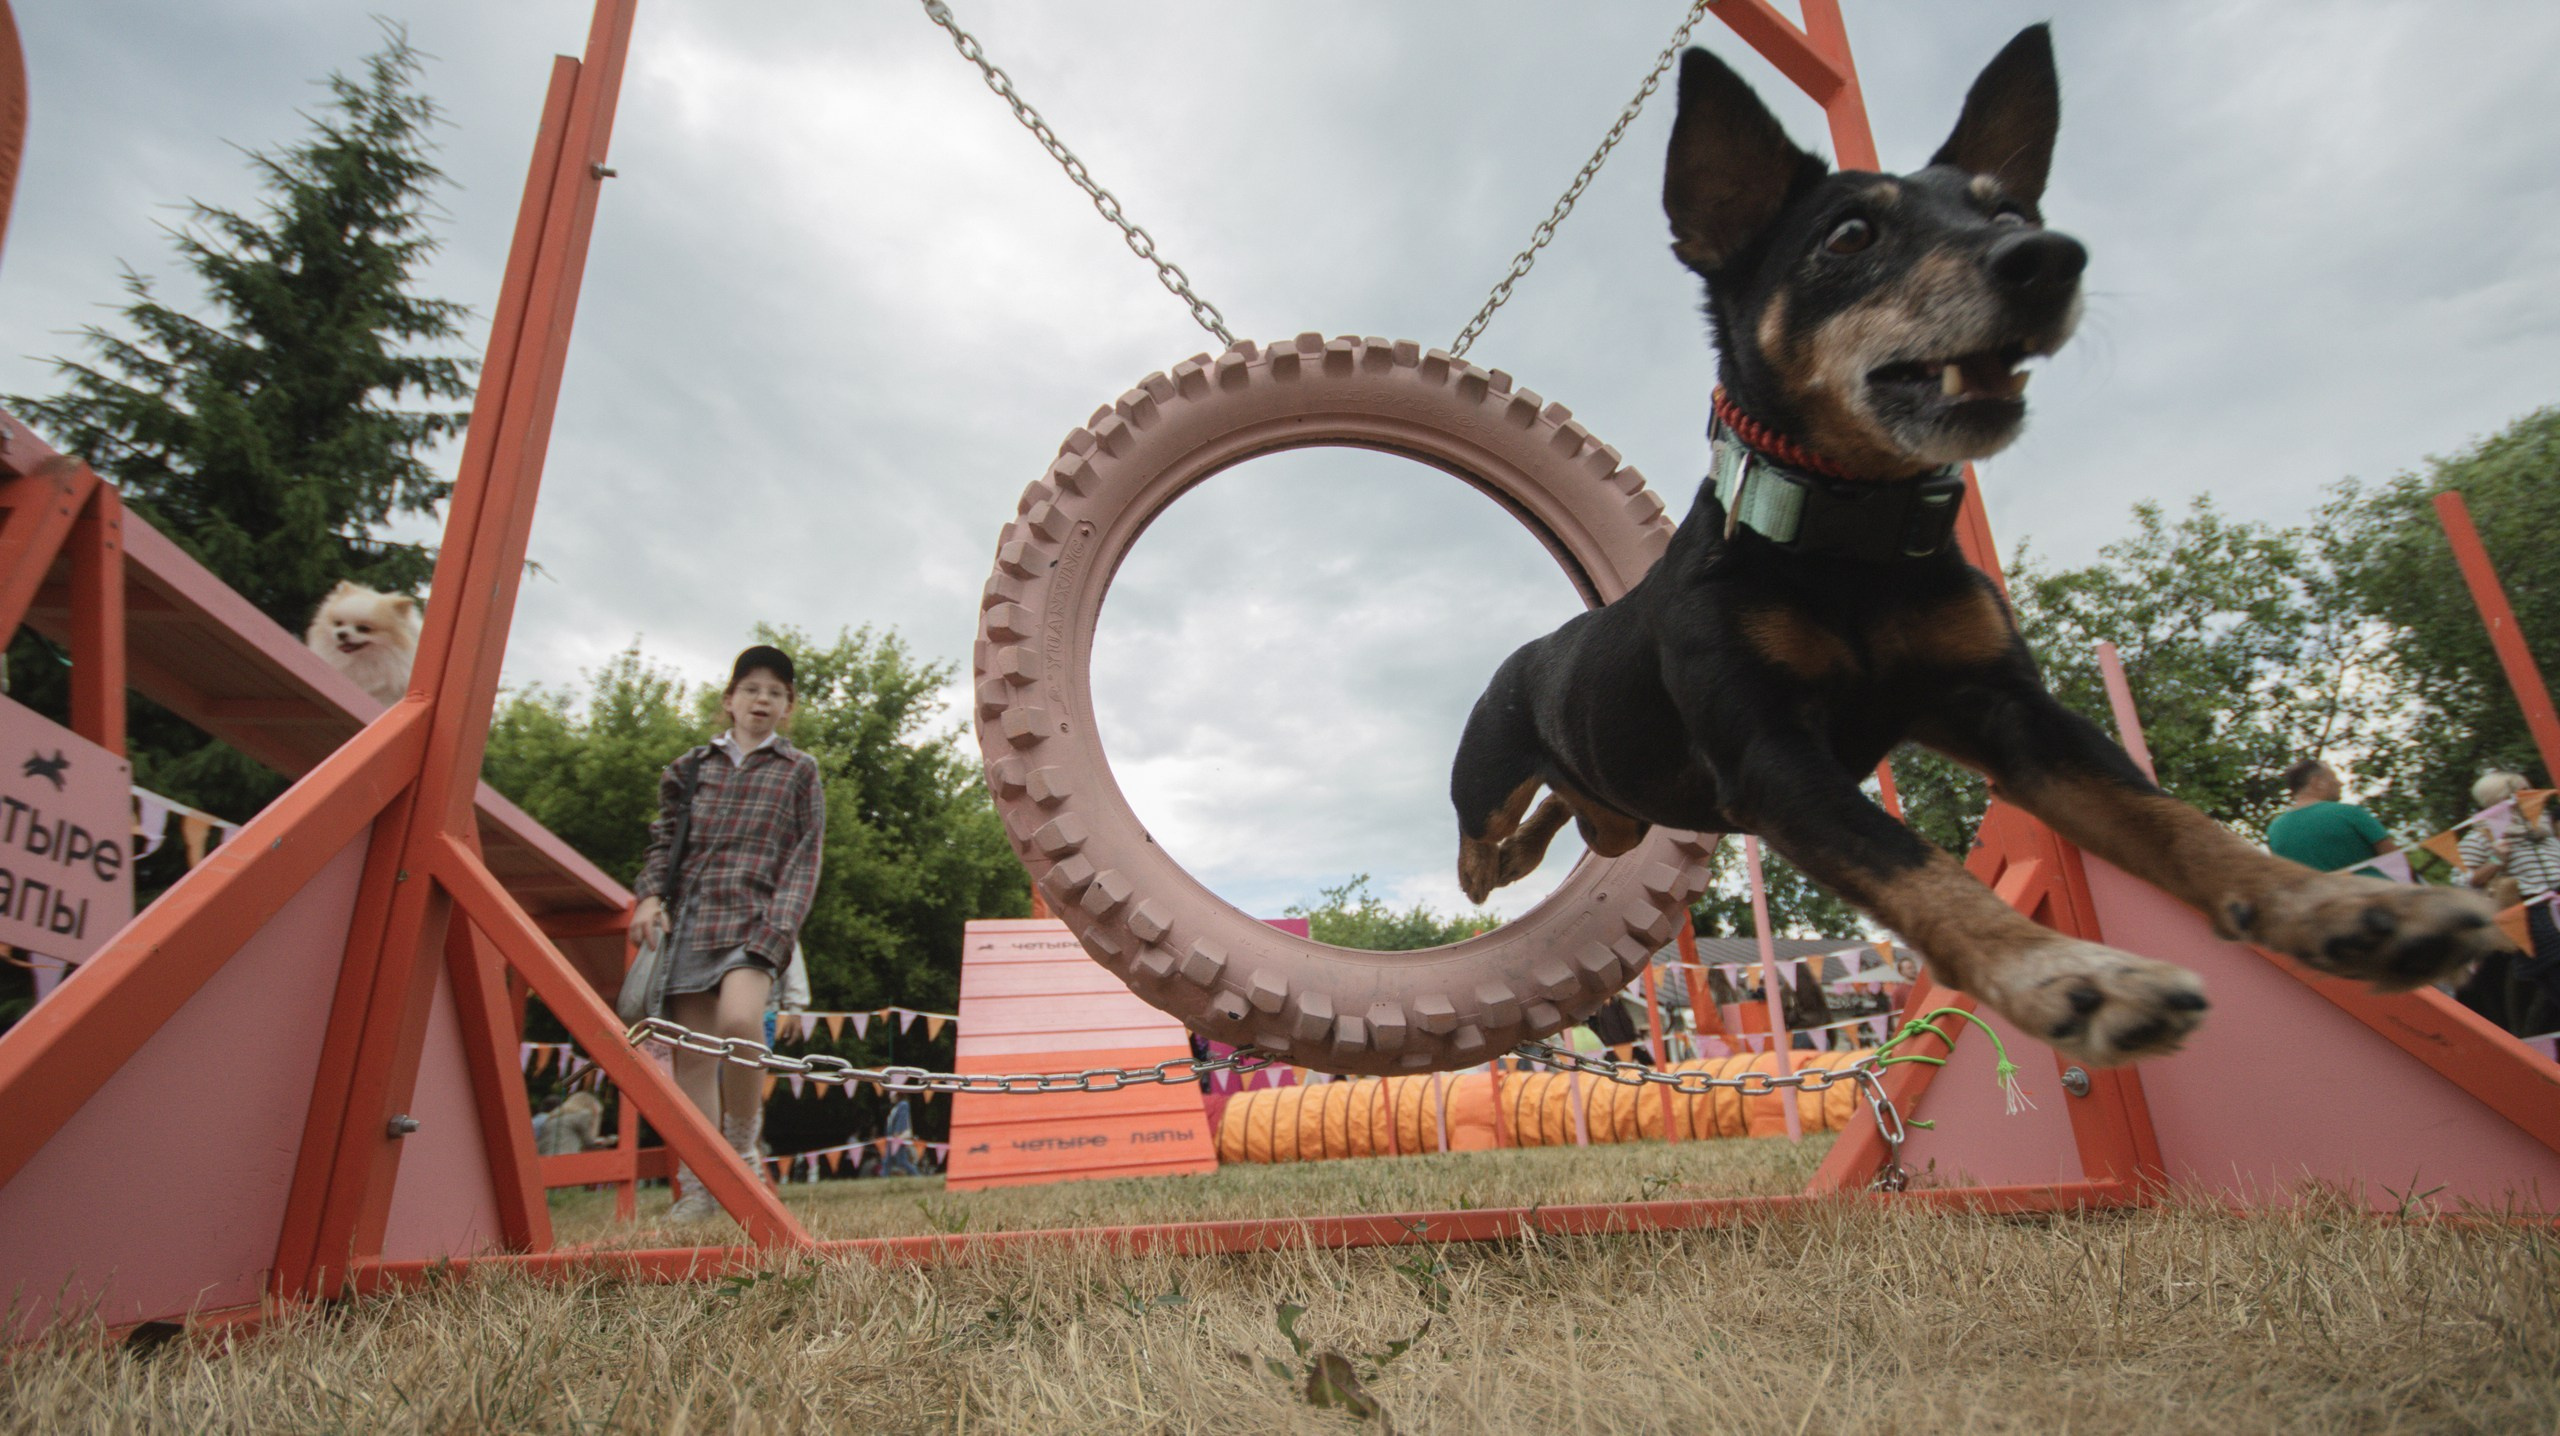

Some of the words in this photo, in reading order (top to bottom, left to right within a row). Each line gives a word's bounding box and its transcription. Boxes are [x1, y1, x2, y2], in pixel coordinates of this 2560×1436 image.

[1046, 539, 1084, 670] YUANXING
[0, 795, 122, 882] тыре
[1013, 1134, 1107, 1152] четыре
[1130, 1129, 1194, 1144] лапы
